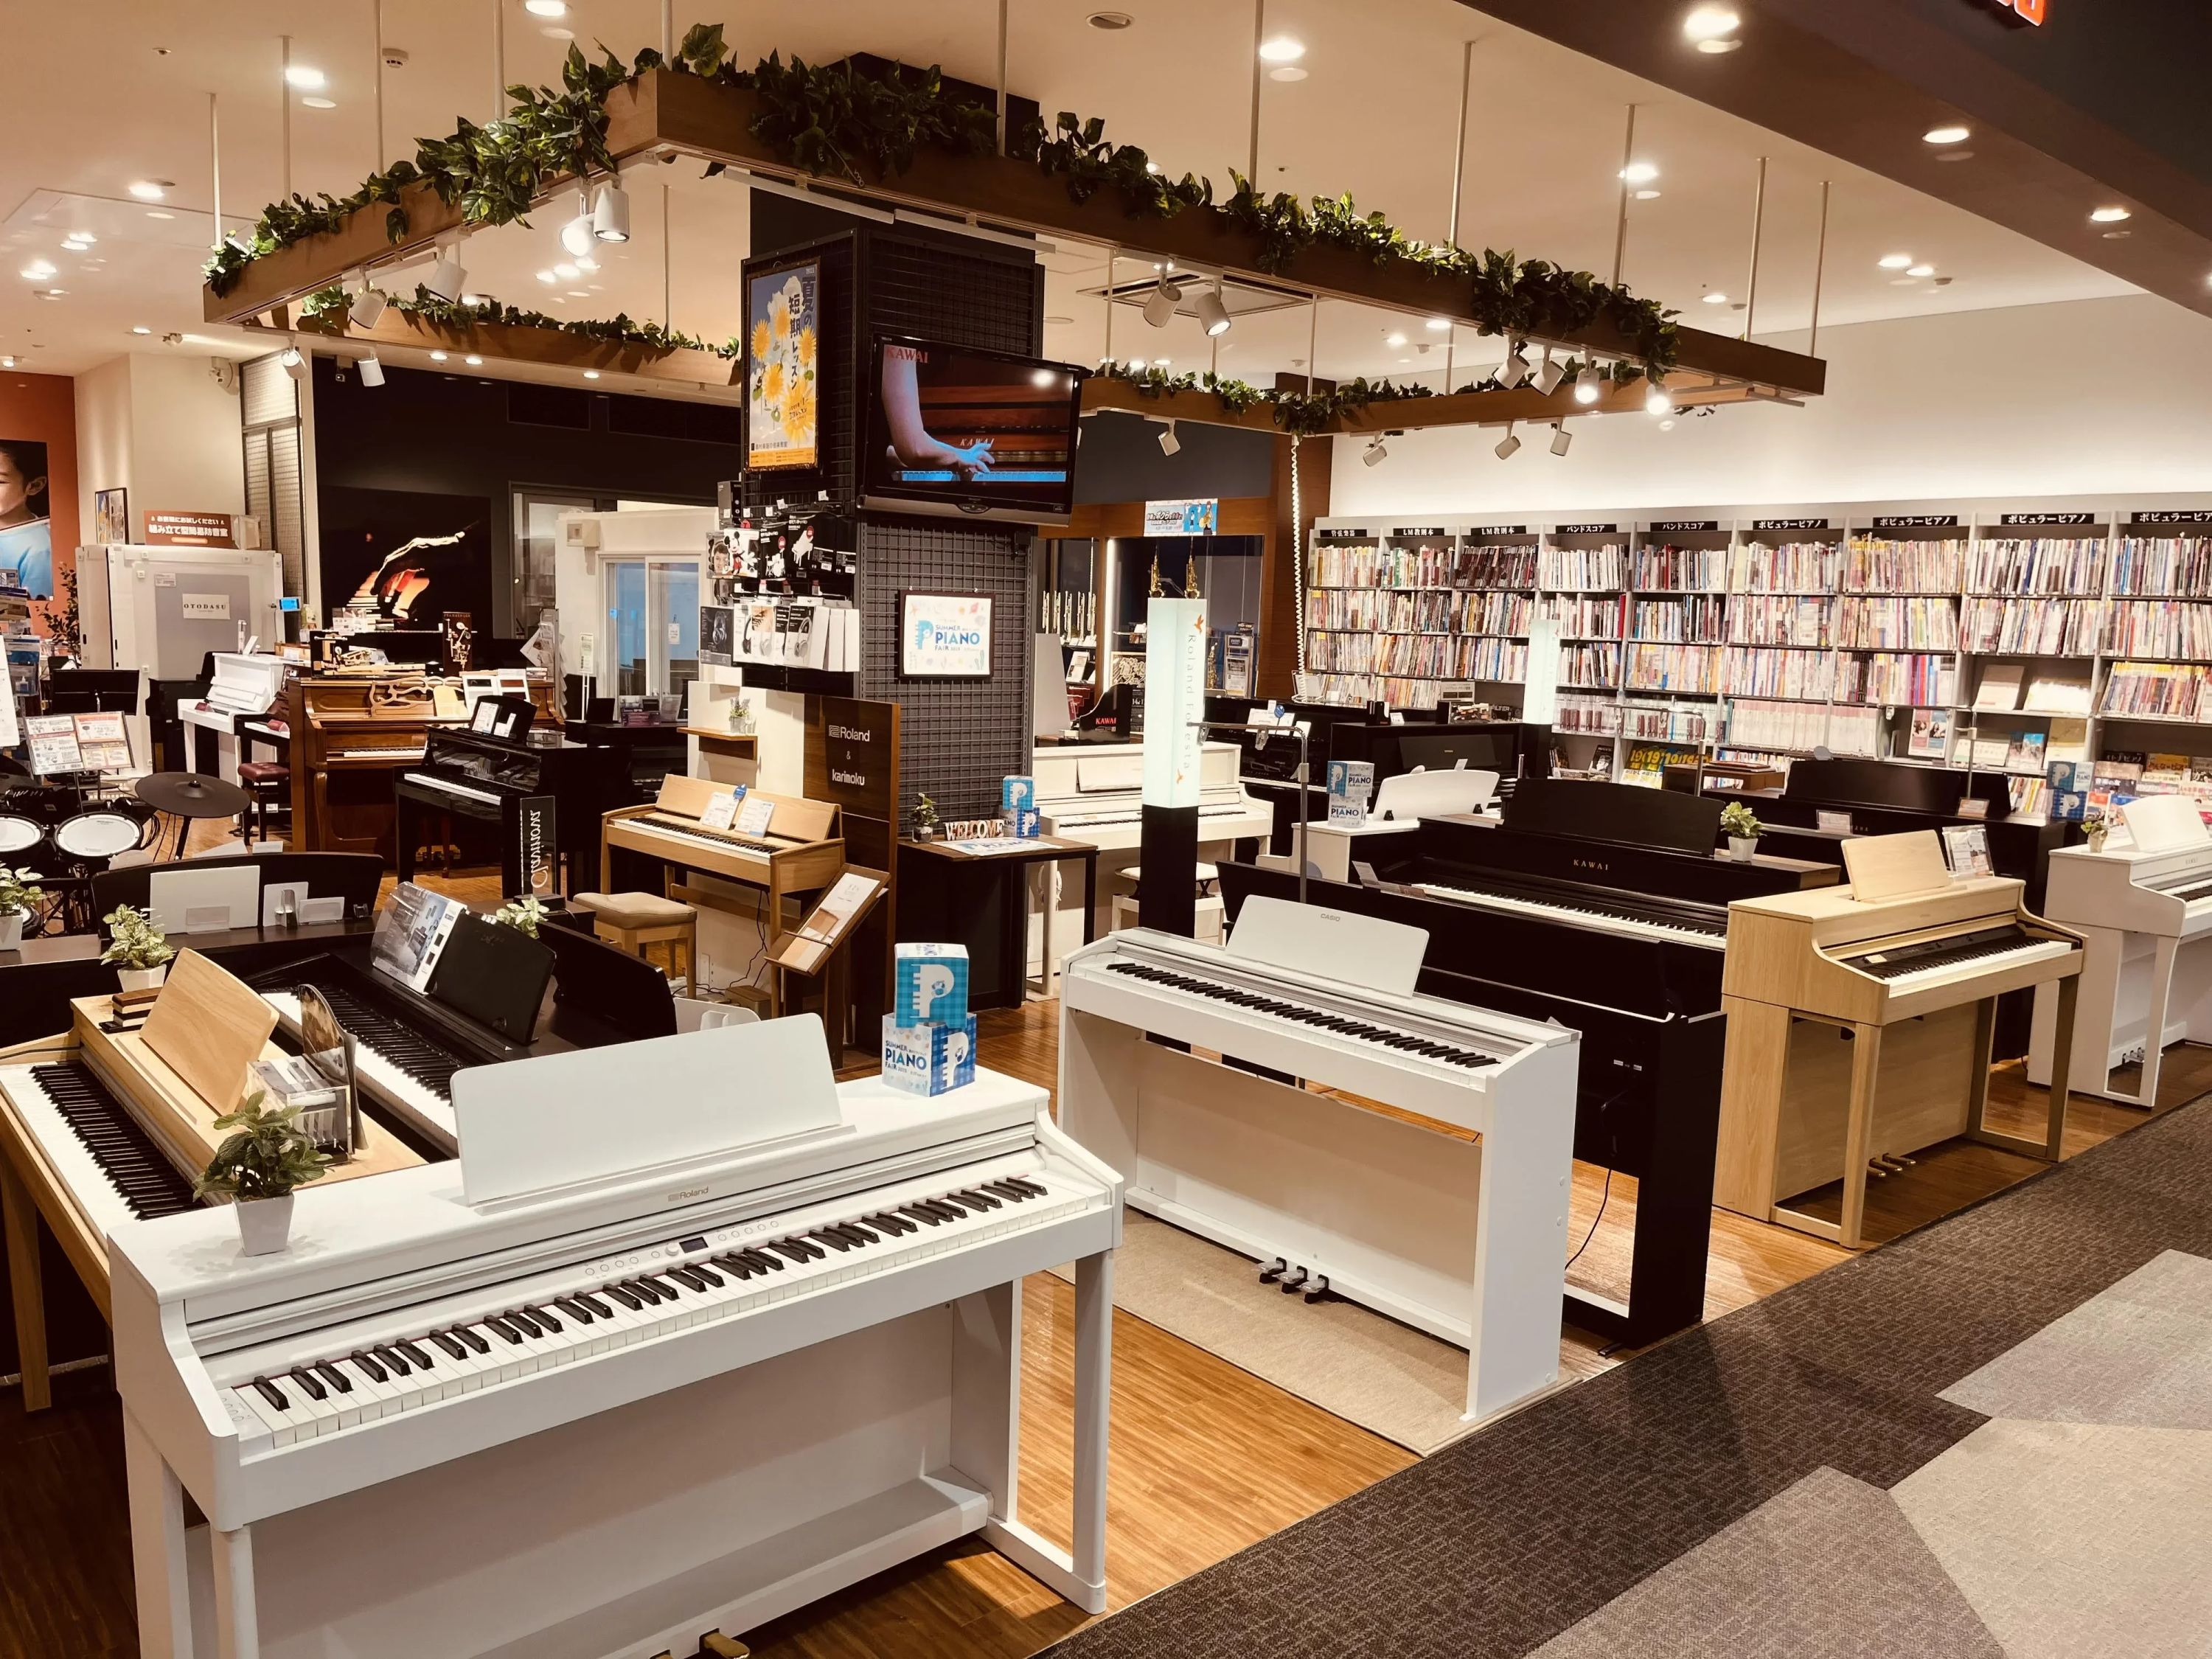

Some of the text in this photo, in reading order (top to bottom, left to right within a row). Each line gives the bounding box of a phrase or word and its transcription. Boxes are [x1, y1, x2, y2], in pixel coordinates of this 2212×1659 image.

[801, 276, 816, 325] 夏の
[789, 293, 801, 390] 短期レッスン
[886, 346, 928, 364] KAWAI
[960, 438, 995, 447] KAWAI
[1879, 517, 1950, 527] ポピュラーピアノ
[2008, 514, 2087, 524] ポピュラーピアノ
[2139, 512, 2212, 523] ポピュラーピア
[1566, 525, 1605, 533] バンドスコア
[1663, 522, 1705, 531] バンドスコア
[1759, 520, 1821, 529] ポピュラーピアノ
[935, 632, 980, 645] PIANO
[1184, 635, 1197, 769] Roland Foesta
[841, 726, 870, 742] Roland
[846, 751, 851, 759] &
[832, 768, 865, 786] karimoku
[1331, 808, 1359, 816] PIANO
[943, 818, 1005, 841] WELCOME
[1573, 859, 1609, 871] KAWAI
[1321, 914, 1340, 922] CASIO
[886, 1040, 908, 1051] SUMMER
[886, 1047, 928, 1071] PIANO
[885, 1061, 897, 1071] FAIR
[680, 1186, 709, 1200] Roland
